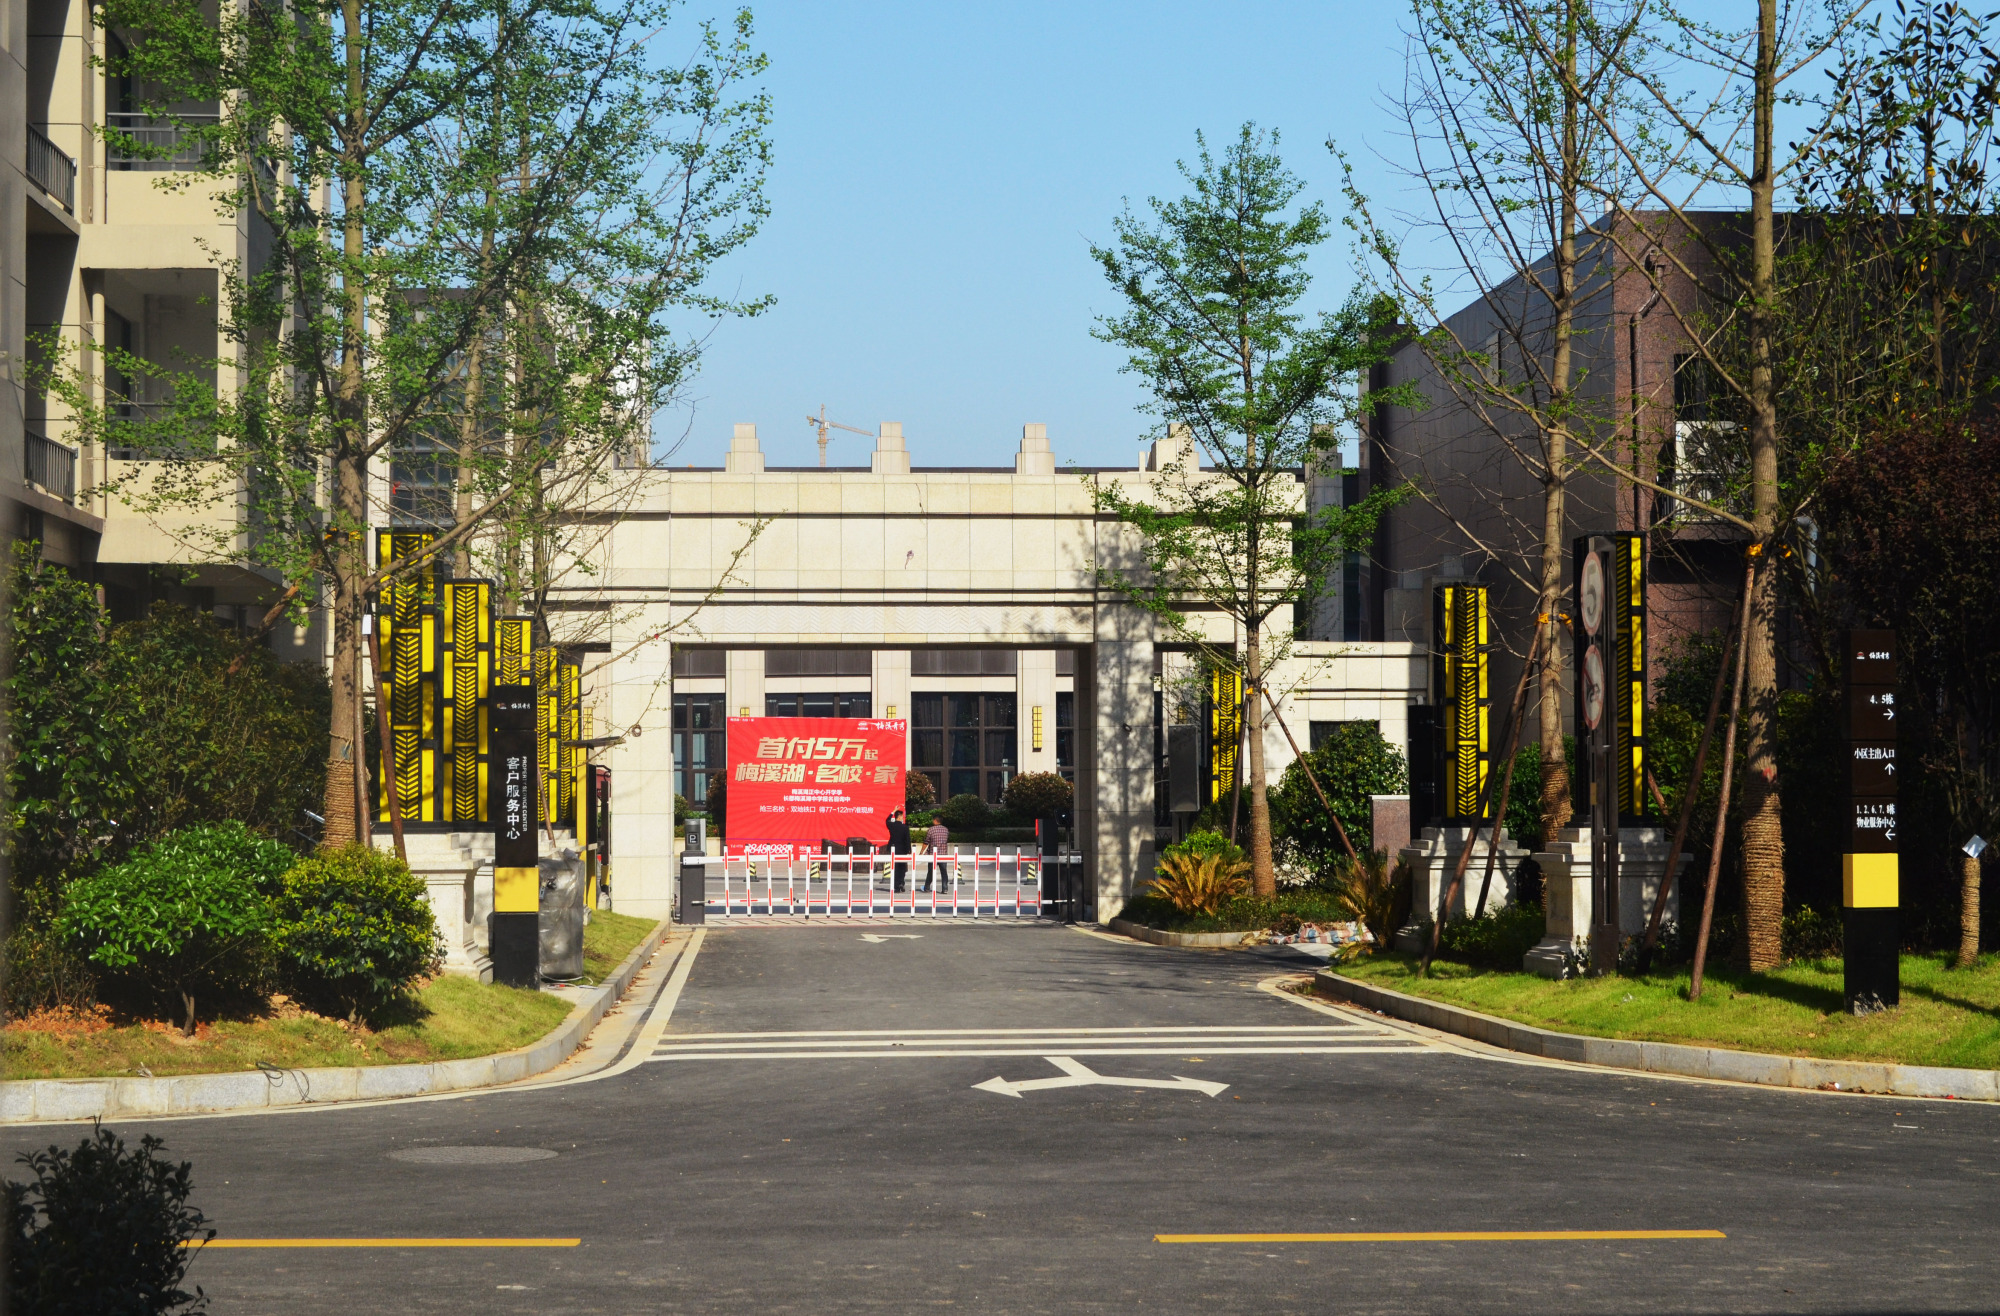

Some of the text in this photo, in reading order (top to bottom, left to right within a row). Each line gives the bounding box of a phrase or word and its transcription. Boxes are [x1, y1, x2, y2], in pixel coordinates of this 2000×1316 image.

[1587, 562, 1597, 617] 5
[756, 736, 879, 760] 首付5万起
[1853, 747, 1895, 760] 小区主出入口
[735, 763, 899, 784] 梅溪湖·名校·家
[506, 757, 520, 840] 客户服务中心
